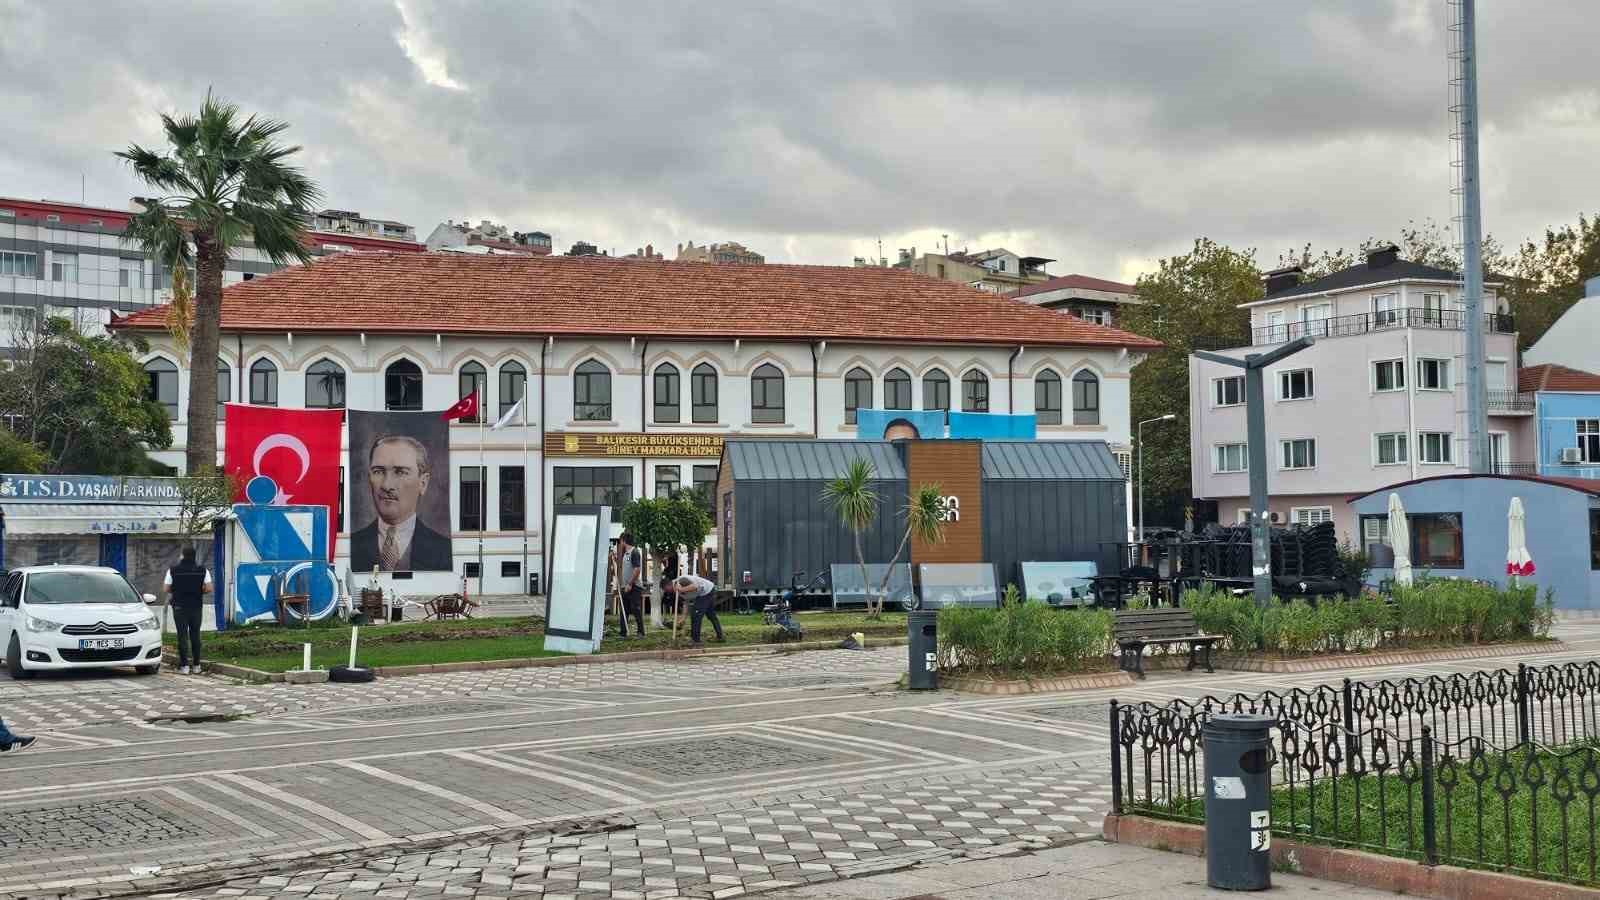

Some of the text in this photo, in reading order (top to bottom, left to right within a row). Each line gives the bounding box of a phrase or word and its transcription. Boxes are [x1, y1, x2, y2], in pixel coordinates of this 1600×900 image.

[597, 435, 648, 446] BALIKESİR
[650, 435, 712, 446] BÜYÜKŞEHİR
[607, 445, 638, 455] GÜNEY
[641, 446, 689, 455] MARMARA
[18, 480, 77, 496] T.S.D.
[78, 483, 120, 499] YAŞAM
